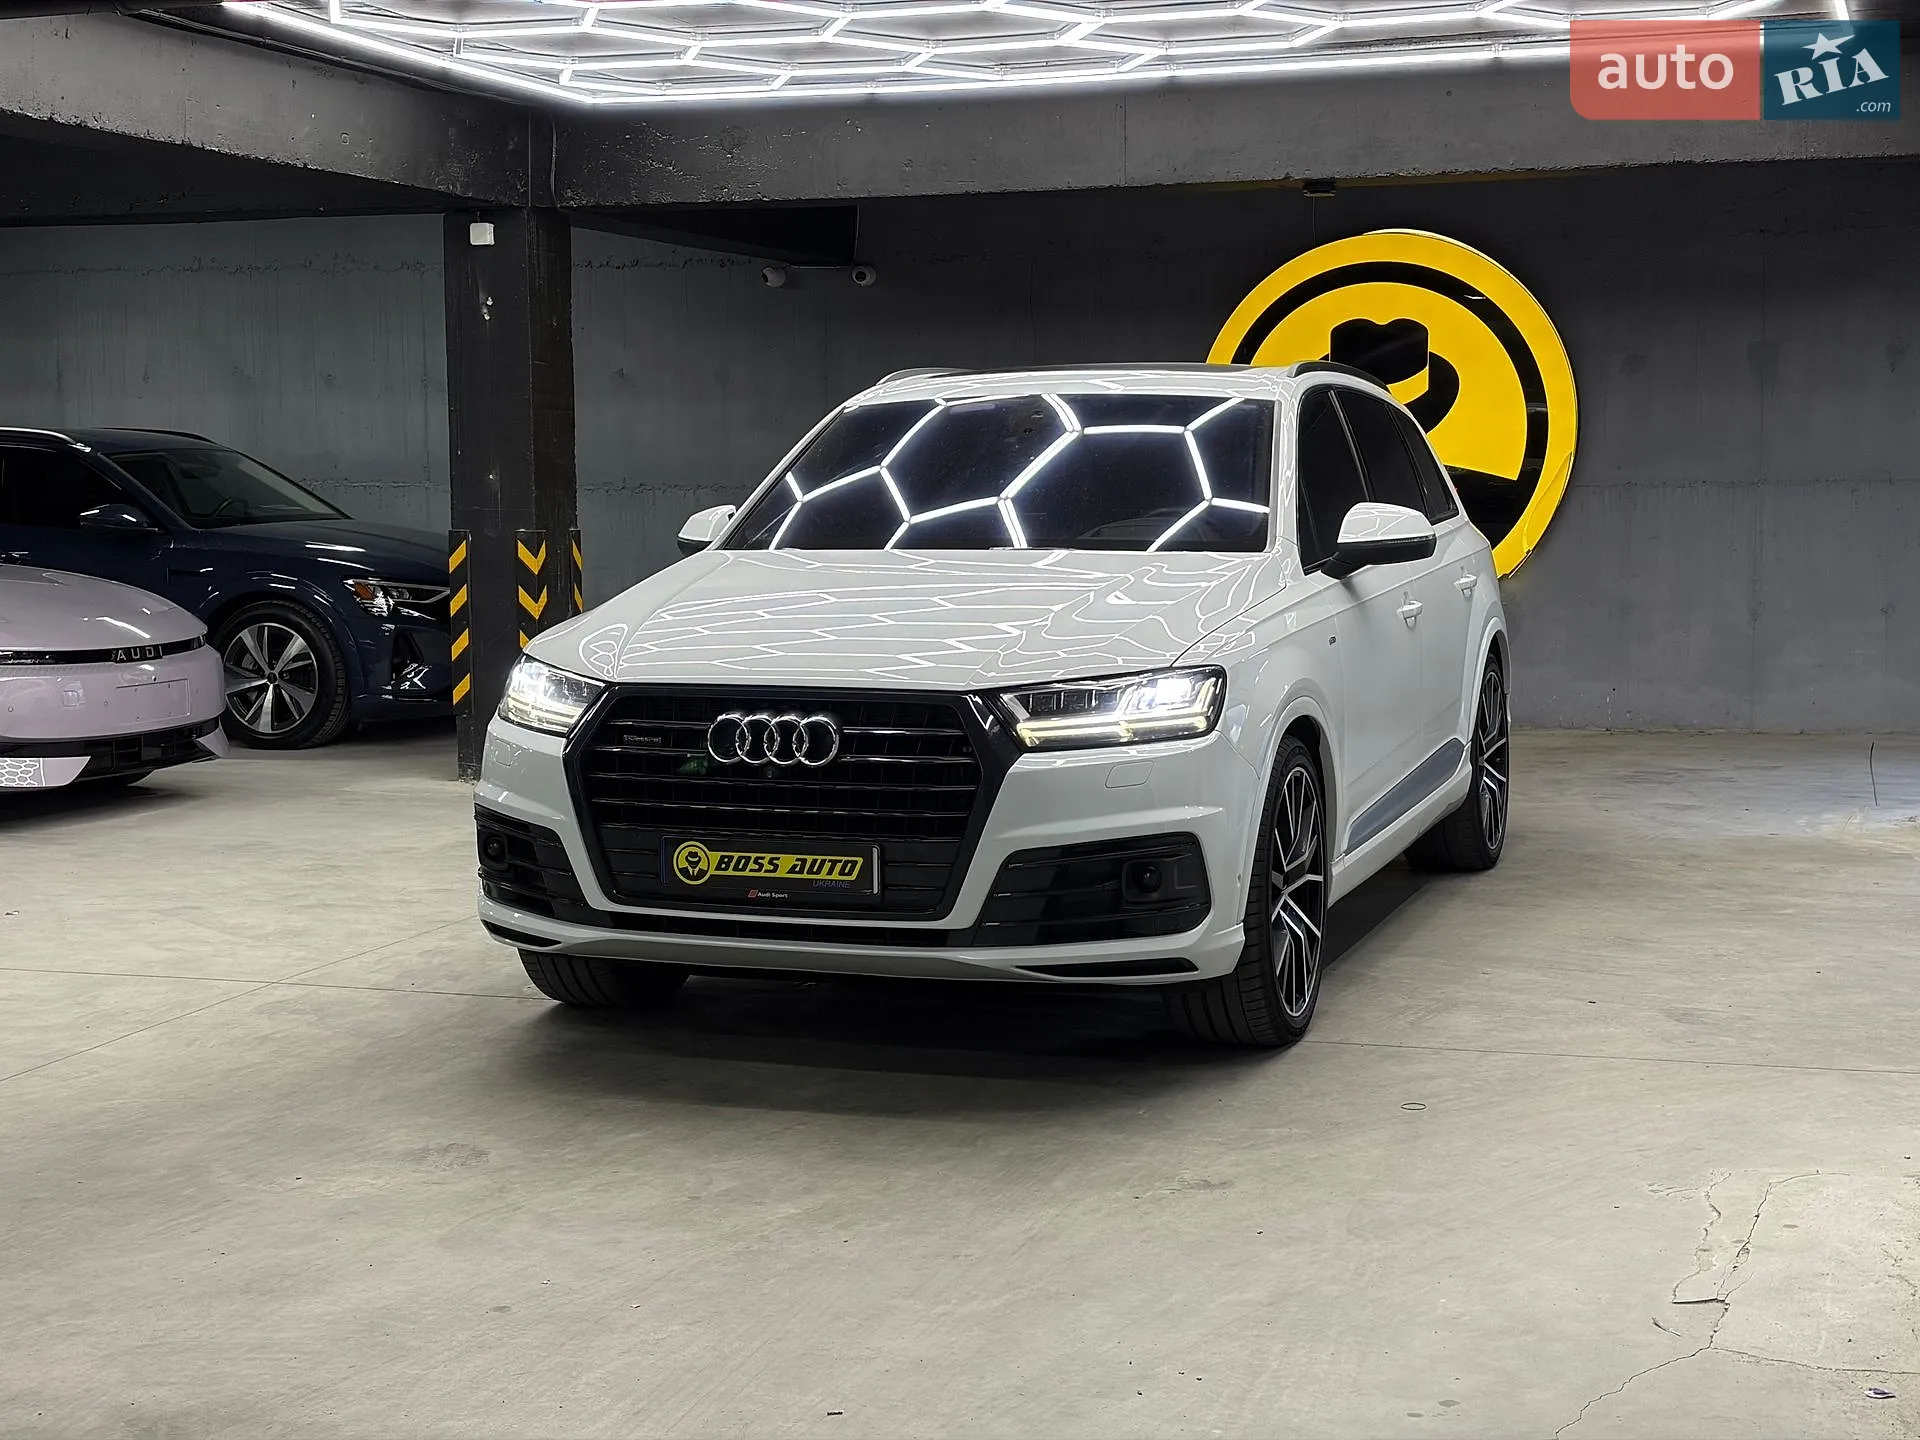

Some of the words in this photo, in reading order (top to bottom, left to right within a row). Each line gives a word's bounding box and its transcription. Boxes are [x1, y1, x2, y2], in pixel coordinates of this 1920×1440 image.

[117, 645, 163, 661] AUDI
[714, 854, 781, 874] BOSS
[786, 857, 860, 877] AUTO
[812, 879, 851, 889] UKRAINE
